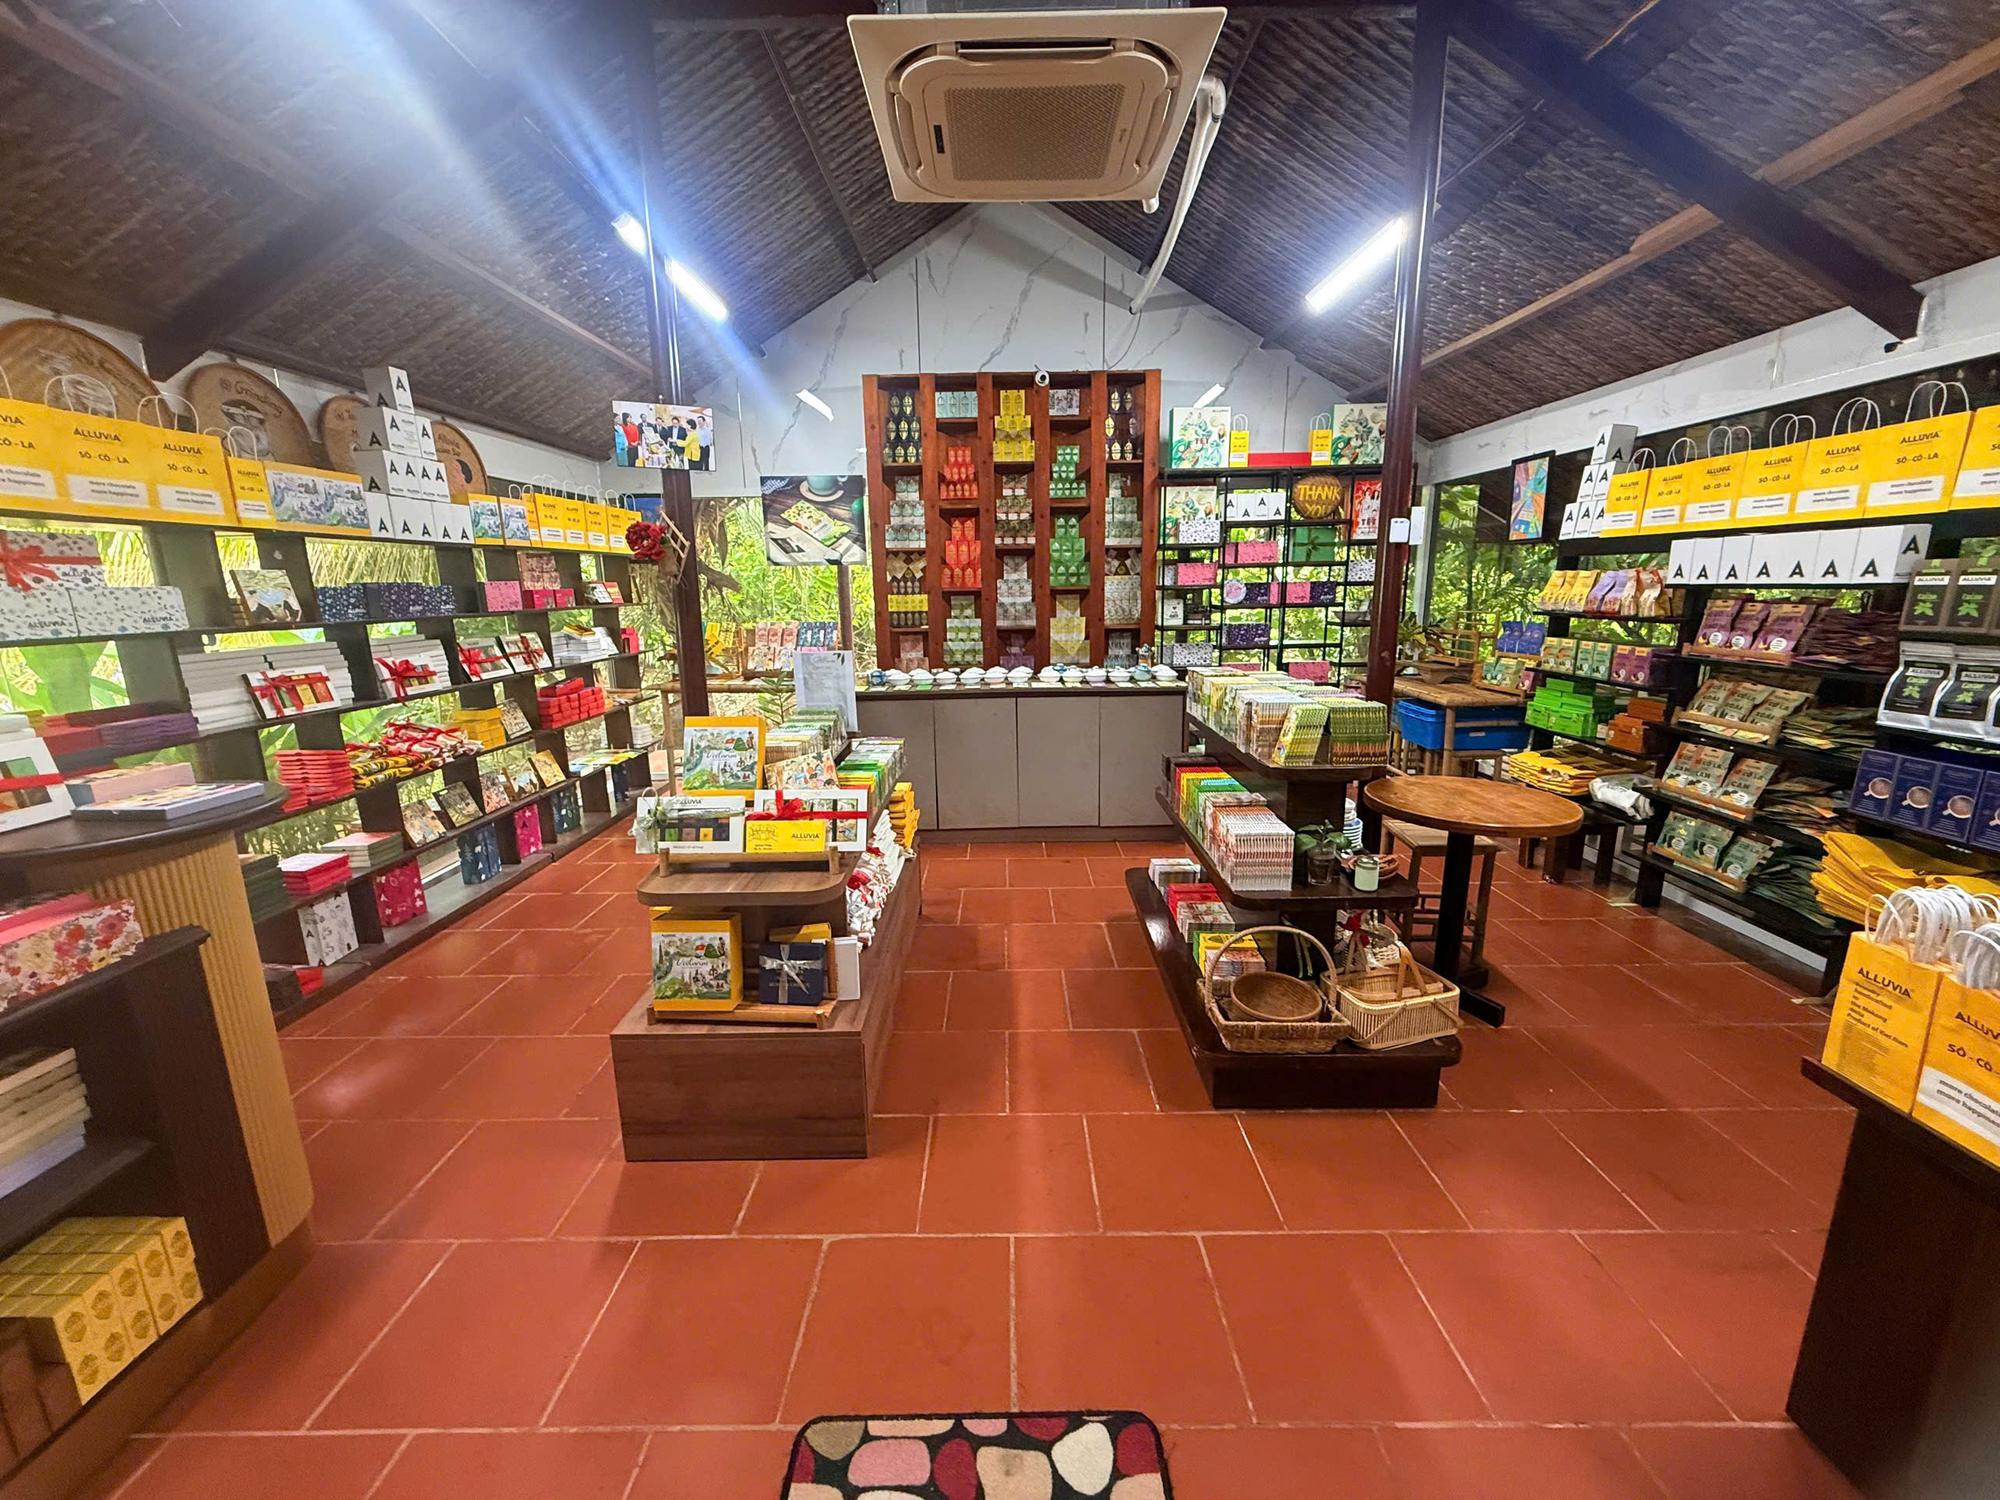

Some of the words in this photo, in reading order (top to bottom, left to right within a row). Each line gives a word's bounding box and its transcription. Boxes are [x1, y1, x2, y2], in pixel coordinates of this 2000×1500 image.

[396, 376, 407, 392] A
[390, 416, 400, 432] A
[73, 428, 122, 442] ALLUVIA
[369, 432, 382, 446] A
[422, 424, 432, 440] A
[1597, 432, 1606, 446] A
[1900, 432, 1941, 444] ALLUVIA
[163, 442, 202, 454] ALLUVIA
[1826, 445, 1862, 456] ALLUVIA
[1764, 456, 1793, 466] ALLUVIA
[1928, 452, 1939, 460] LA
[390, 460, 400, 475] A
[406, 462, 416, 477] A
[422, 466, 432, 481] A
[1706, 465, 1732, 474] ALLUVIA
[436, 468, 445, 482] A
[1585, 470, 1594, 484] A
[1599, 470, 1608, 482] A
[368, 476, 381, 492] A
[1297, 484, 1341, 500] THANK
[1226, 500, 1234, 508] A
[1258, 498, 1266, 506] A
[1242, 508, 1250, 517] A
[1274, 507, 1282, 516] A
[1306, 503, 1331, 516] YOU
[1565, 510, 1574, 522] A
[1582, 506, 1590, 520] A
[378, 518, 389, 533] A
[402, 520, 412, 534] A
[422, 523, 432, 537] A
[442, 526, 452, 540] A
[461, 528, 470, 541] A
[1902, 535, 1920, 554] A
[1674, 563, 1684, 578] A
[1696, 564, 1709, 580] A
[1725, 564, 1738, 580] A
[1756, 560, 1771, 578] A
[1789, 560, 1804, 578] A
[1822, 559, 1839, 578] A
[1860, 558, 1878, 577] A
[1858, 967, 1912, 999] ALLUVIA
[1846, 1012, 1870, 1028] Product
[1938, 1079, 1962, 1095] more
[1936, 1088, 1961, 1104] more
